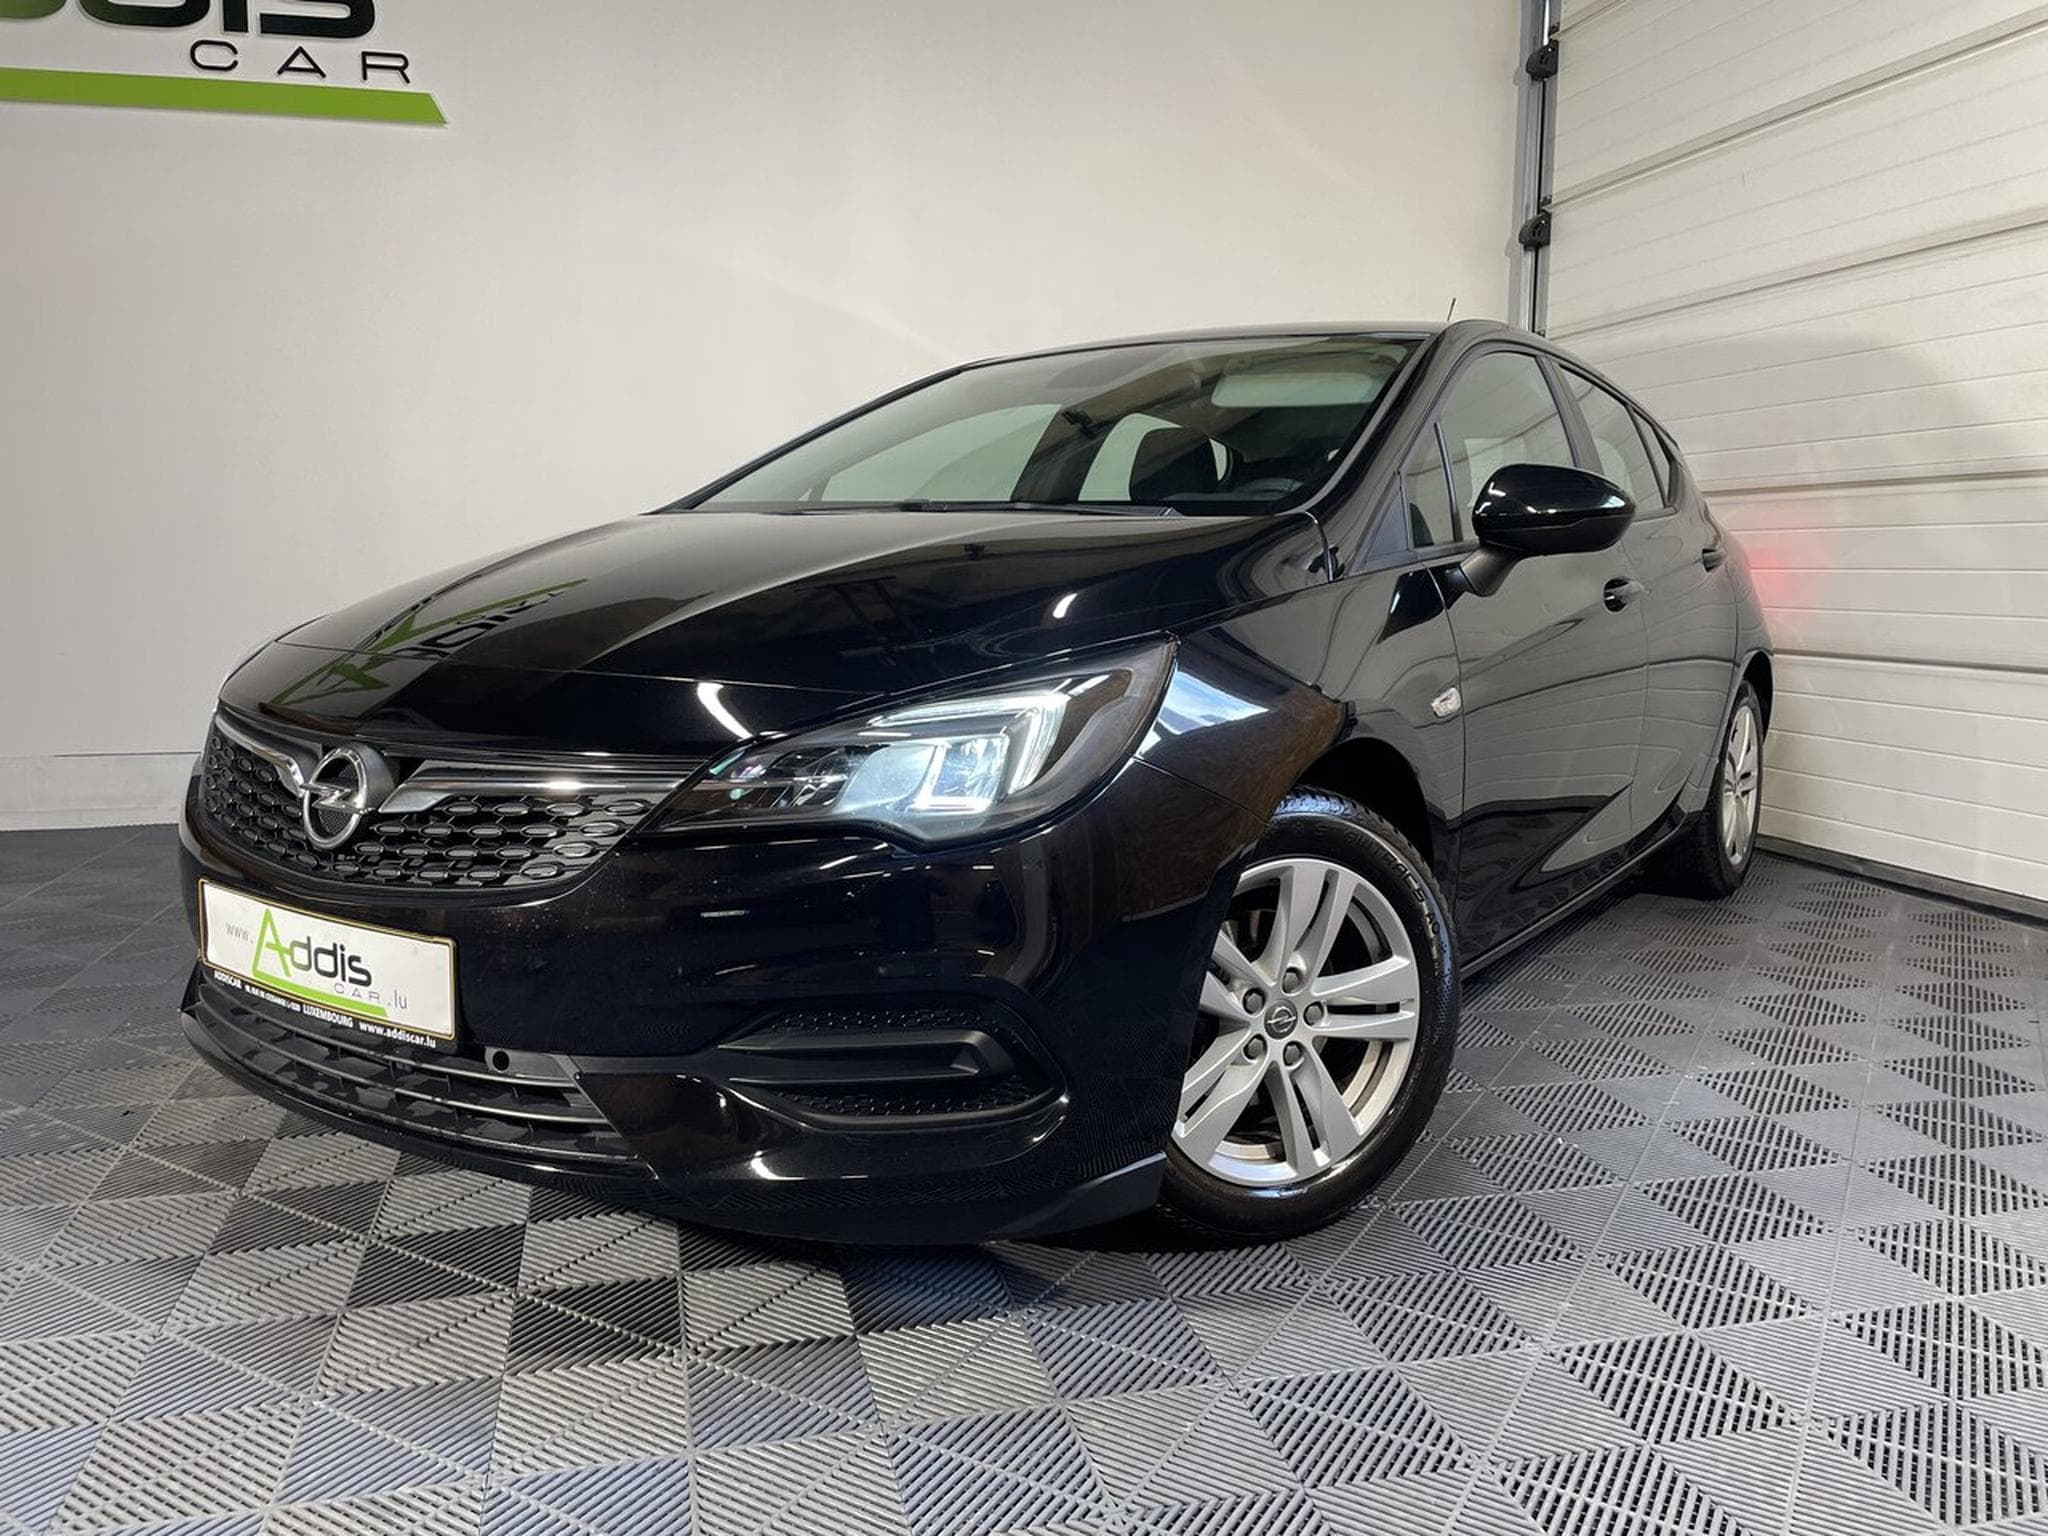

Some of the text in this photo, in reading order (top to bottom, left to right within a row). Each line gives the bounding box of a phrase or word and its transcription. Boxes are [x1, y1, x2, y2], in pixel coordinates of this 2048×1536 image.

[189, 39, 411, 85] CAR
[252, 907, 373, 988] Addis
[302, 1003, 355, 1029] LUXEMBOURG
[358, 1021, 437, 1049] www.addiscar.lu
